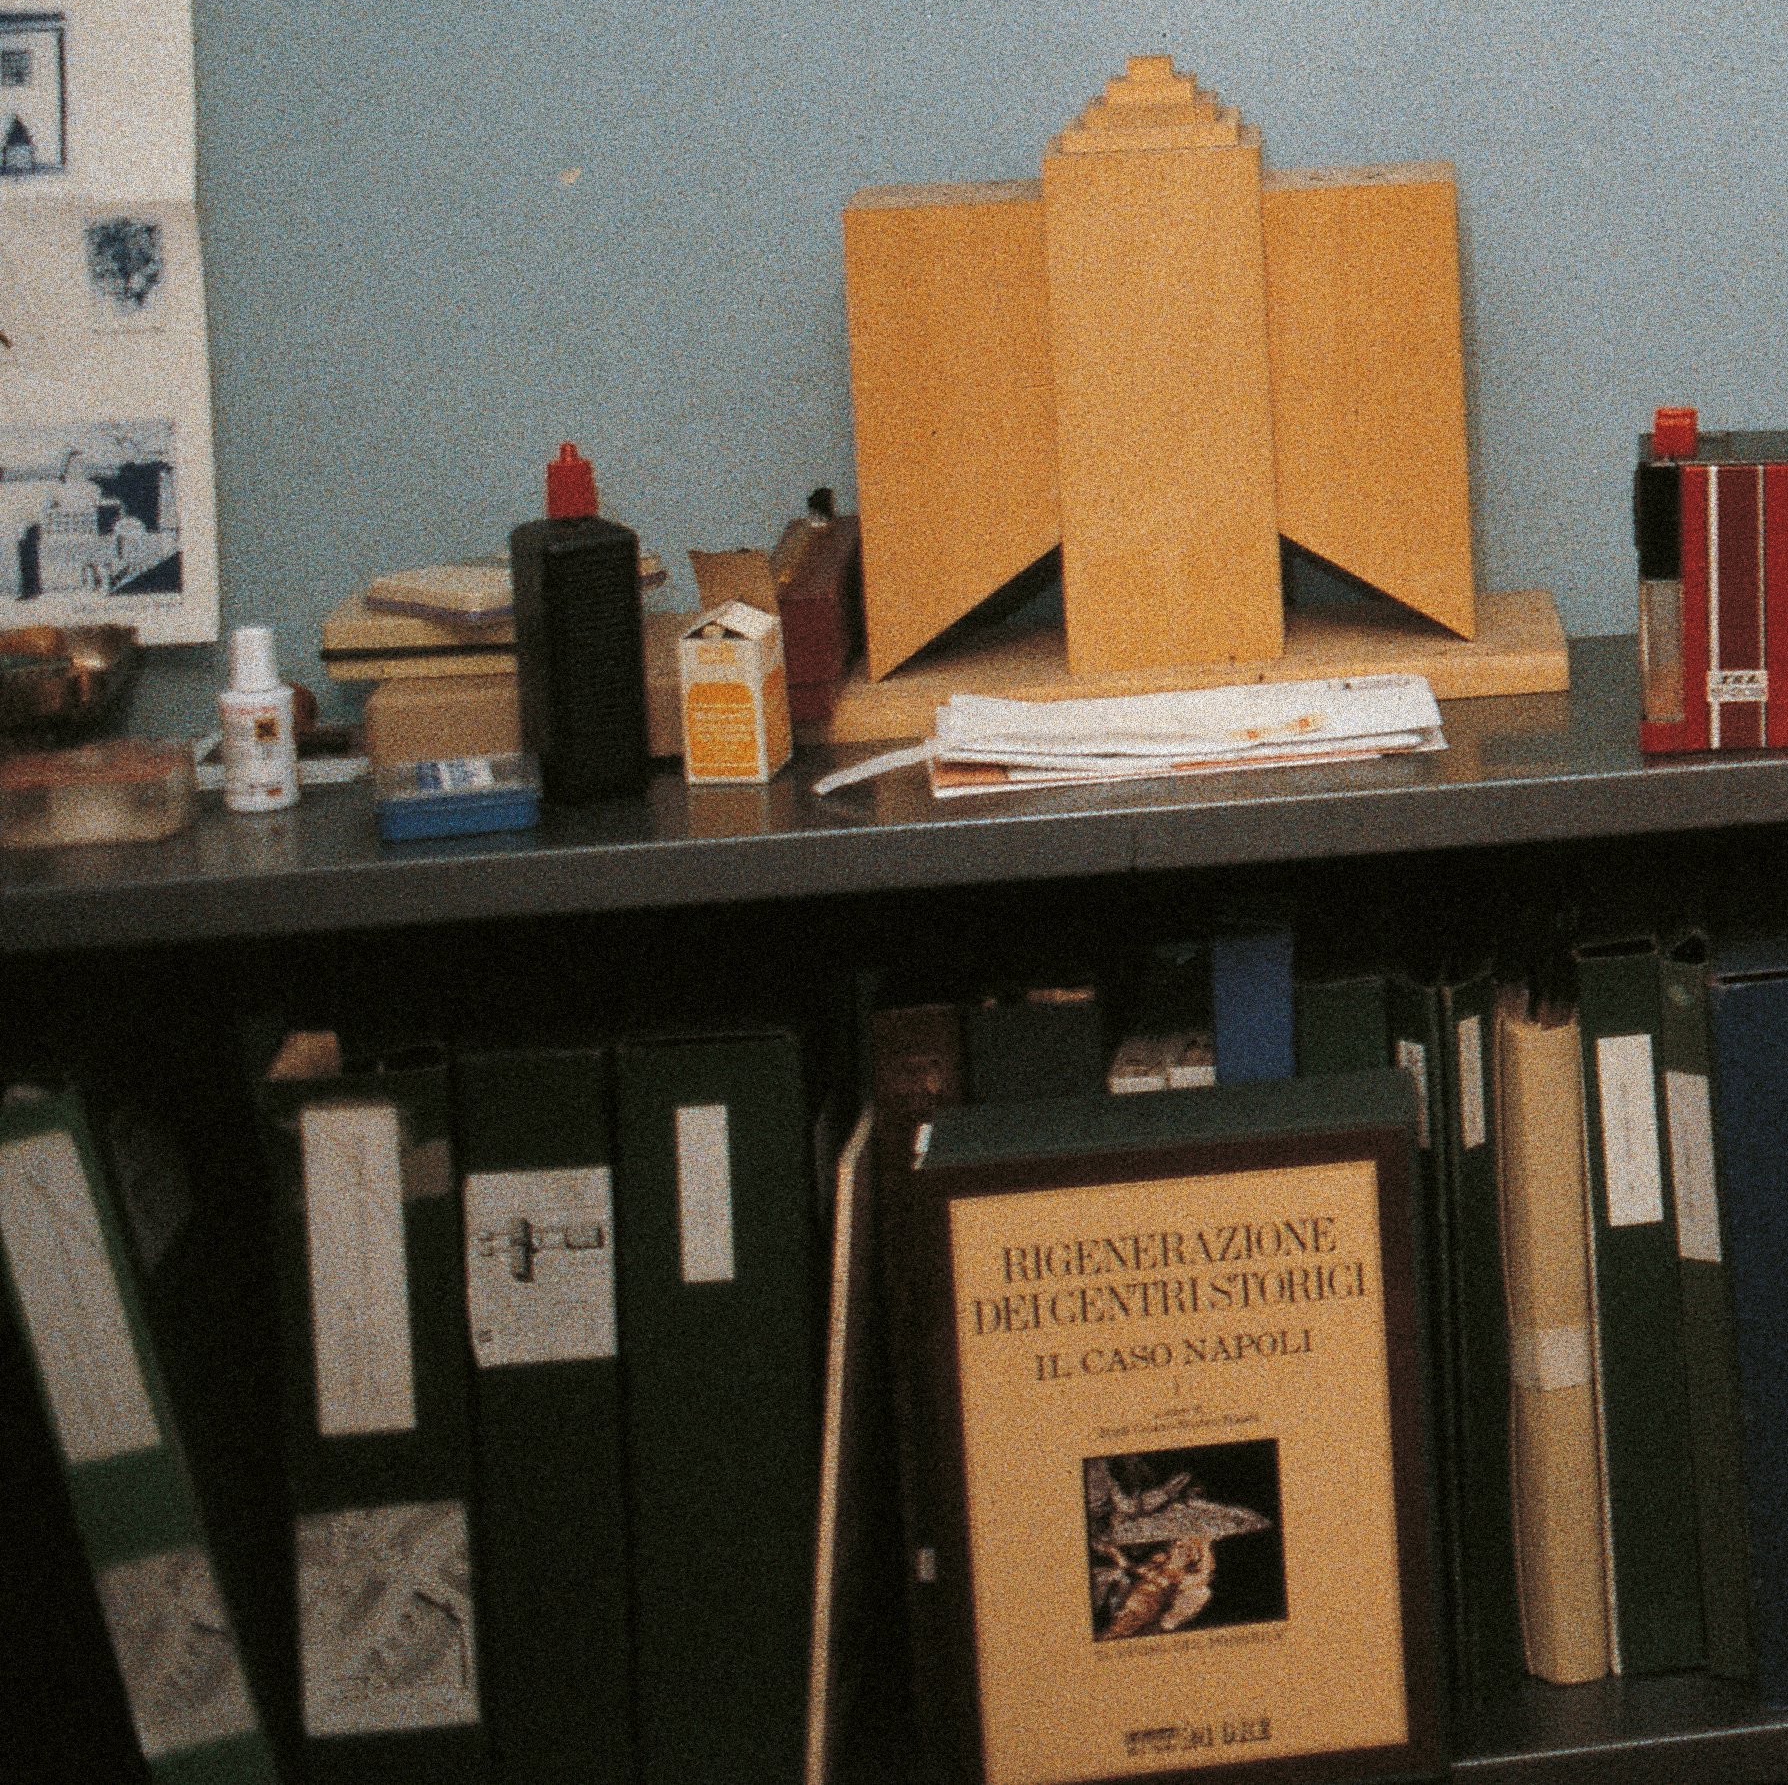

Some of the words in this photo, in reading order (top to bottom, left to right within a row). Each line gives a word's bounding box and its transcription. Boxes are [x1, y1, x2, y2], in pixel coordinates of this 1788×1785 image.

[1002, 1216, 1338, 1283] RIGENERAZIONE
[971, 1291, 1041, 1336] DEI
[1048, 1275, 1200, 1325] CENTRI
[1209, 1261, 1366, 1311] STORICI
[1034, 1353, 1072, 1382] IL
[1080, 1342, 1174, 1376] CASO
[1183, 1328, 1315, 1366] NAPOLI
